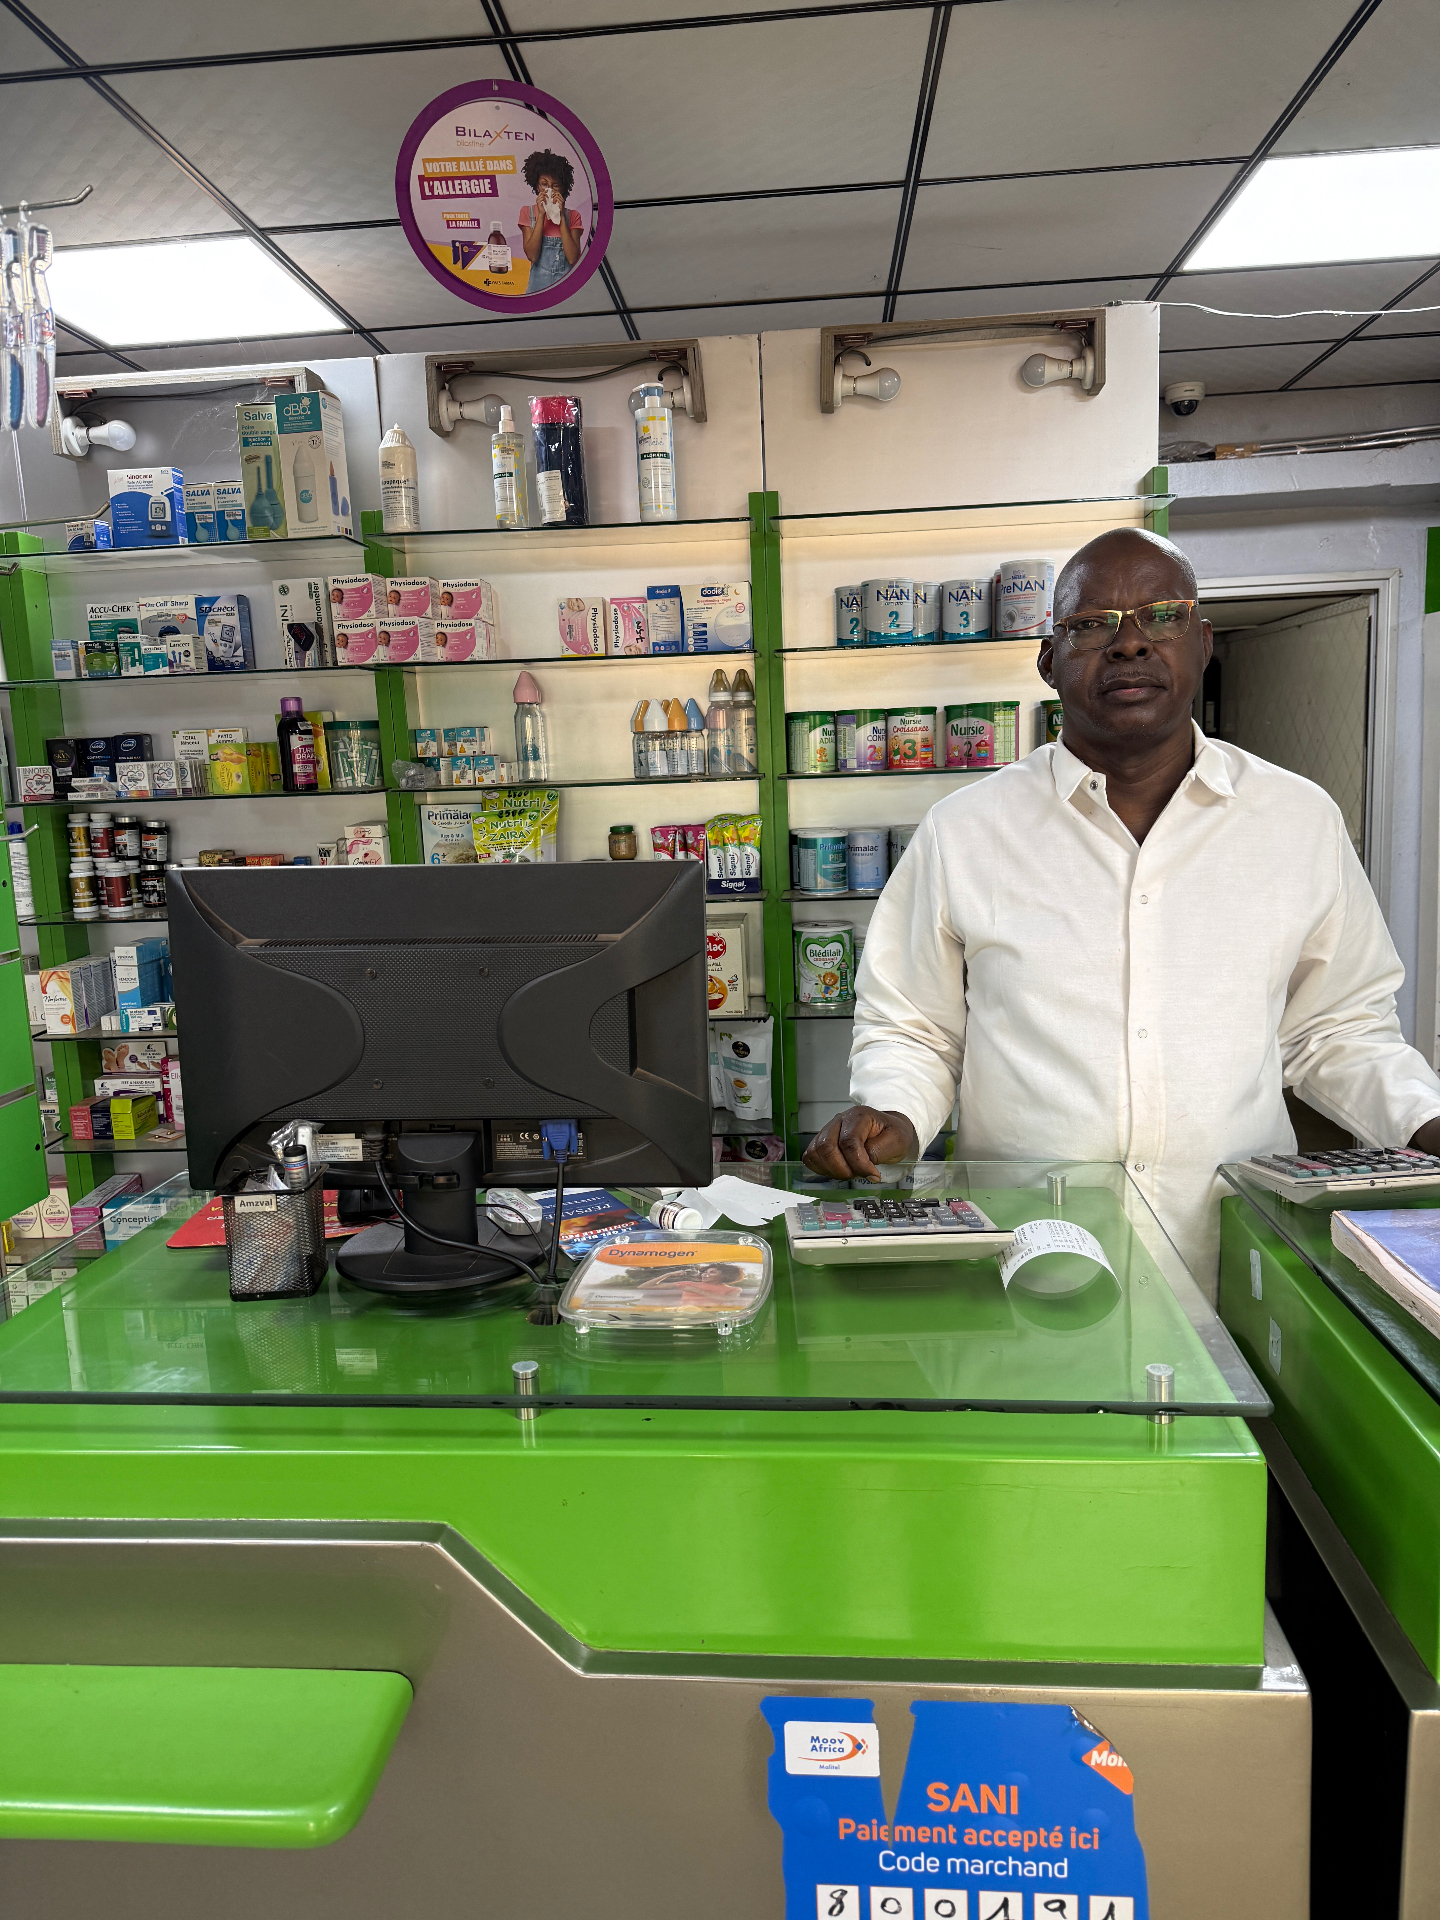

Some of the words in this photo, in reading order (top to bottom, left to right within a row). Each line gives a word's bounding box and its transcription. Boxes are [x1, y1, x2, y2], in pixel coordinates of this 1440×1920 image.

[455, 124, 535, 145] BILAXTEN
[425, 161, 458, 173] VOTRE
[459, 158, 486, 172] ALLIÉ
[487, 160, 514, 172] DANS
[424, 178, 493, 196] L'ALLERGIE
[457, 220, 479, 228] FAMILLE
[243, 411, 274, 421] Salva
[185, 490, 211, 498] SALVA
[216, 487, 241, 496] SALVA
[332, 576, 370, 585] Physiodose
[390, 579, 427, 587] Physiodose
[876, 588, 910, 602] NAN
[948, 589, 982, 603] NAN
[840, 596, 863, 609] NA
[88, 604, 132, 615] ACCU-CHEK
[337, 621, 374, 630] Physiodose
[436, 621, 473, 629] Physiodose
[888, 610, 901, 629] 2
[959, 610, 970, 629] 3
[590, 607, 600, 652] Physiodose
[612, 607, 621, 648] Physiodose
[849, 617, 860, 635] 2
[892, 725, 929, 734] Croissance
[950, 723, 985, 737] Nursie
[866, 744, 876, 761] 2
[903, 738, 917, 760] 3
[963, 740, 973, 758] 2
[503, 798, 540, 808] Nutri
[490, 818, 523, 830] Nutri
[489, 830, 527, 842] ZAIRA
[829, 853, 843, 862] PRE
[729, 852, 737, 877] Signal
[744, 852, 752, 876] Signal
[875, 866, 880, 876] 1
[720, 880, 747, 890] Signal
[809, 948, 842, 958] Blédilait
[239, 1198, 273, 1208] Amzval
[594, 1221, 637, 1235] CONTRE
[608, 1248, 695, 1259] Dynamogen
[809, 1735, 845, 1745] Moov
[810, 1743, 845, 1753] Africa
[926, 1782, 1019, 1815] SANI
[838, 1817, 957, 1845] Paiement
[963, 1825, 1063, 1852] accepté
[1070, 1826, 1099, 1850] ici
[878, 1849, 940, 1873] Code
[946, 1855, 1069, 1878] marchand
